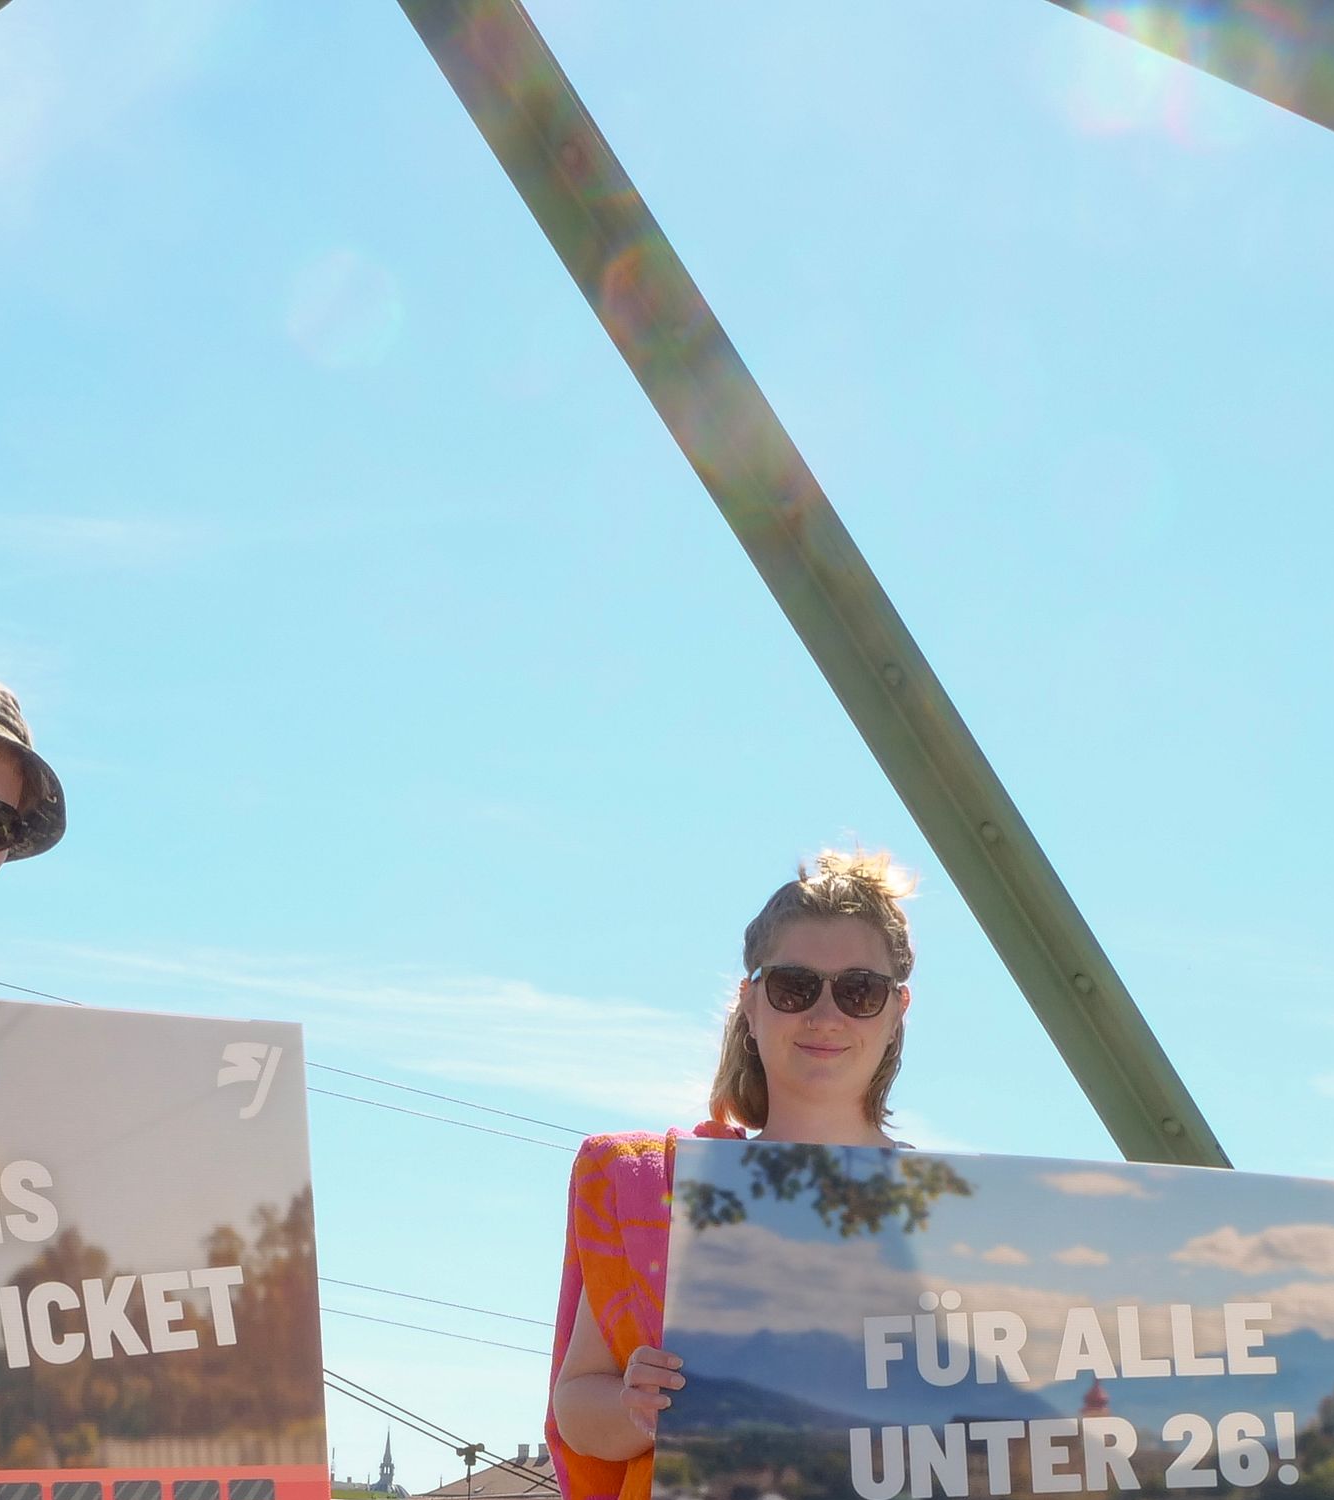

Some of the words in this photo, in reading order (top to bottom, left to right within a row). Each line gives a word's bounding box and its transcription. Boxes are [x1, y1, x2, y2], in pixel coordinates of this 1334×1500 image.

[863, 1290, 1031, 1390] FÜR
[1053, 1302, 1278, 1383] ALLE
[1162, 1410, 1300, 1490] 26!
